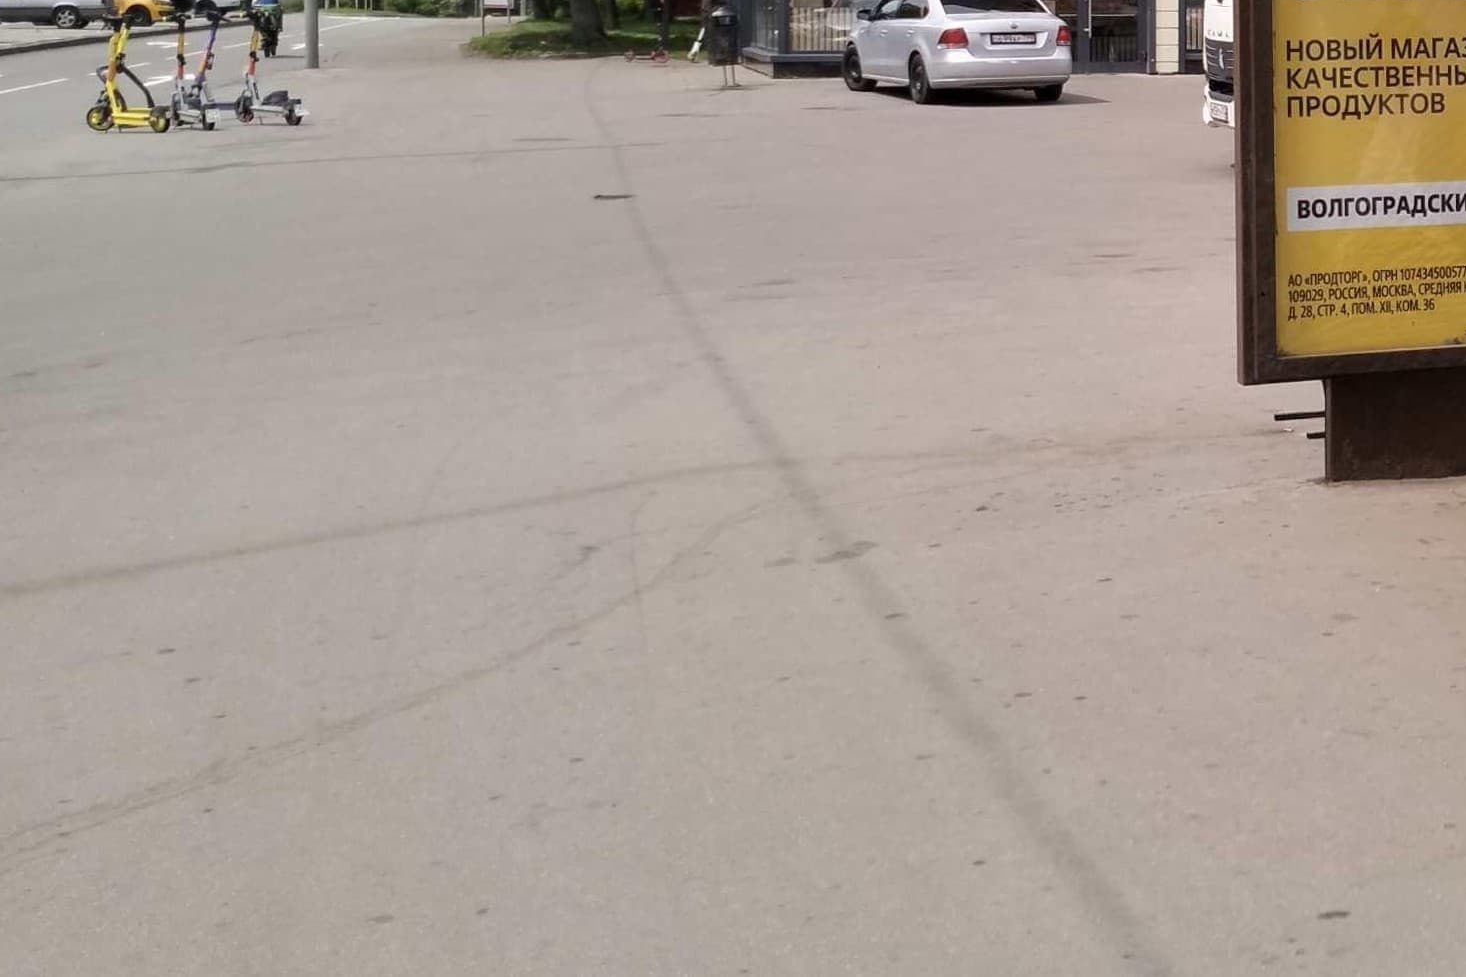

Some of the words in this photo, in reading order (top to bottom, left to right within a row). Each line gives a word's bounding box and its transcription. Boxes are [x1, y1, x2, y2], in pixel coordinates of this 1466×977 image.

[1286, 33, 1383, 62] НОВЫЙ
[1287, 92, 1446, 120] ПРОДУКТОВ
[1288, 274, 1303, 287] АО
[1305, 270, 1371, 288] «ПРОДТОРГ»,
[1372, 269, 1398, 282] ОГРН
[1288, 289, 1327, 303] 109029,
[1328, 286, 1371, 300] РОССИЯ,
[1373, 284, 1417, 299] МОСКВА,
[1418, 281, 1462, 296] СРЕДНЯЯ
[1301, 305, 1316, 319] 28,
[1317, 304, 1338, 317] СТР.
[1340, 303, 1350, 317] 4,
[1352, 301, 1378, 315] ПОМ.
[1396, 299, 1421, 312] КОМ.
[1423, 298, 1435, 311] 36
